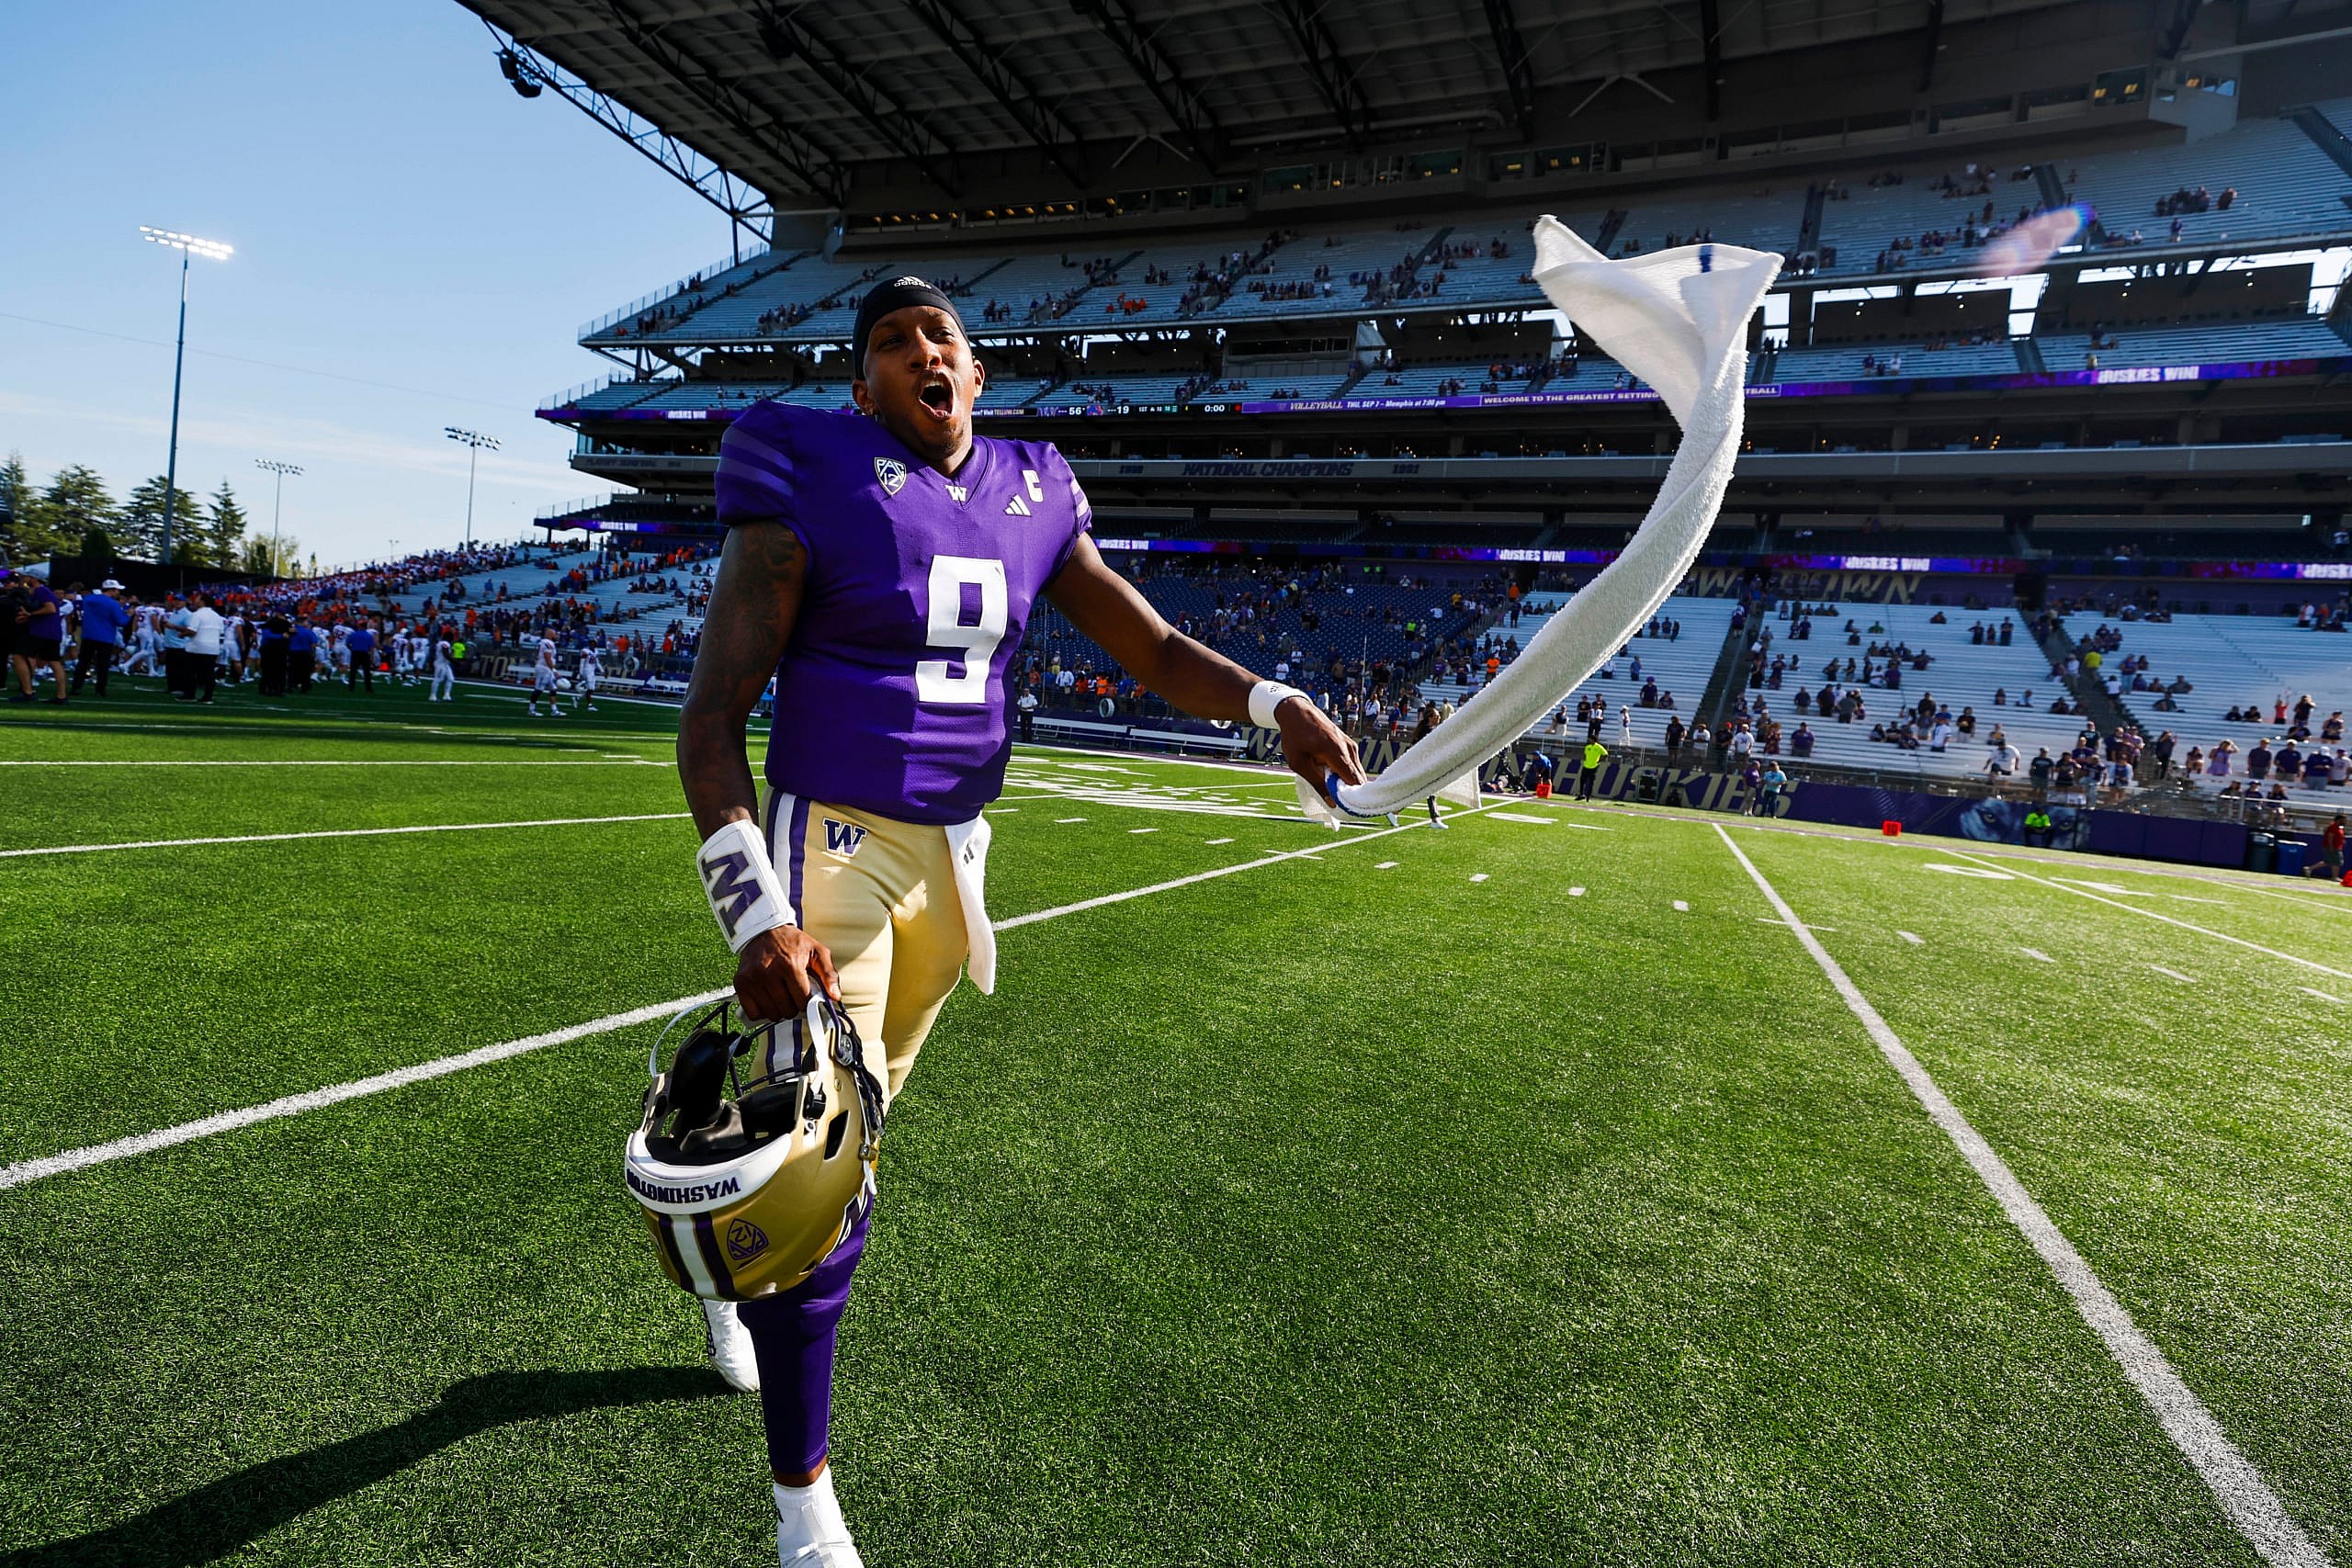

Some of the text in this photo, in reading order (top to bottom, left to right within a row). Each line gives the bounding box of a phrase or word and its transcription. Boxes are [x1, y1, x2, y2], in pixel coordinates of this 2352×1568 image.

[1290, 400, 1343, 411] VOLLEYBALL
[1385, 399, 1414, 409] Memphis
[1484, 396, 1530, 404] WELCOME
[1546, 394, 1564, 402] THE
[1566, 392, 1617, 401] GREATEST
[1117, 405, 1130, 414] 19
[1204, 404, 1225, 412] 0:00
[876, 459, 905, 482] PAC
[1181, 462, 1257, 477] NATIONAL
[1260, 462, 1354, 477] CHAMPIONS
[884, 472, 901, 487] 12
[1022, 469, 1044, 502] C
[945, 484, 967, 502] W
[1498, 548, 1542, 562] HUSKIES
[915, 555, 1009, 704] 9
[822, 818, 868, 856] W
[627, 1168, 741, 1204] WASHINGTON
